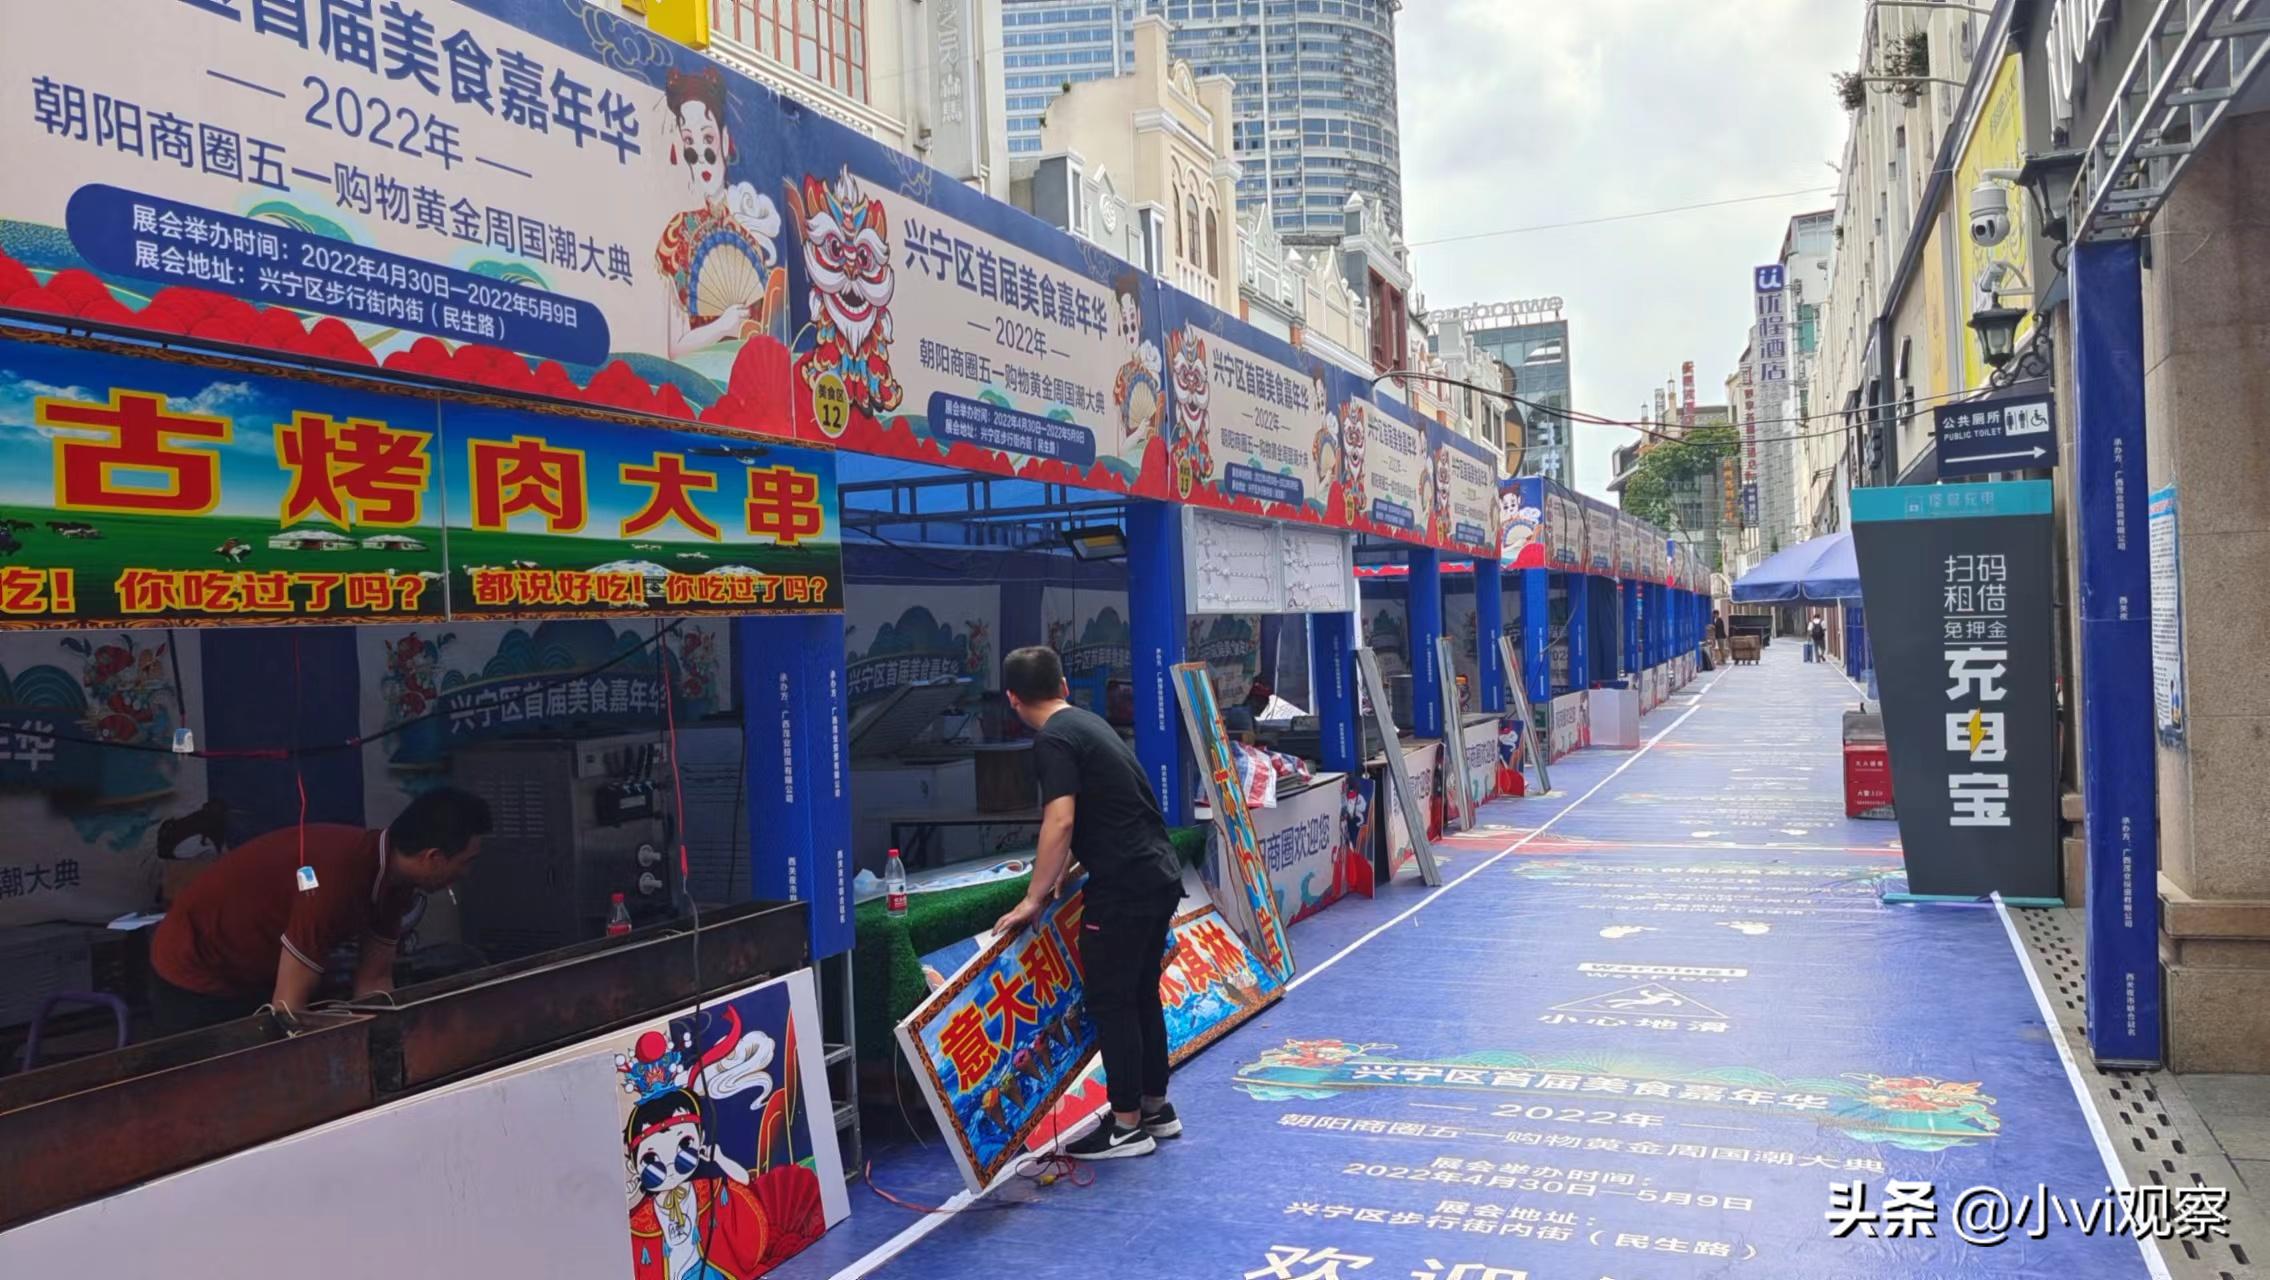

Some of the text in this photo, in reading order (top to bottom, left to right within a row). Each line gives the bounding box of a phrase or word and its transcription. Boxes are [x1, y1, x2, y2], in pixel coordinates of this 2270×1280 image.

[210, 0, 641, 165] 首届美食嘉年华
[303, 75, 463, 170] 2022年
[32, 75, 634, 287] 朝阳商圈五一购物黄金周国潮大典
[903, 218, 1108, 342] 兴宁区首届美食嘉年华
[995, 315, 1048, 361] 2022年
[919, 338, 1106, 416] 朝阳商圈五一购物黄金周国潮大典
[1212, 348, 1310, 416] 兴宁区首届美食嘉年华
[822, 404, 842, 429] 12
[1942, 410, 2000, 429] 公共厕所
[1943, 427, 2002, 442] PUBLIC TOILET
[1944, 554, 2007, 583] 扫码
[1943, 584, 2007, 613] 租借
[1943, 620, 2008, 639] 免押金
[0, 719, 56, 772] 华
[1944, 647, 2011, 827] 充电宝
[1537, 1012, 1731, 1033] 小心地滑
[1352, 1063, 1831, 1113] 兴宁区首届美食嘉年华
[1490, 1102, 1666, 1129] 2022年
[1276, 1111, 1886, 1175] 朝阳商圈五一购物黄金周国潮大典
